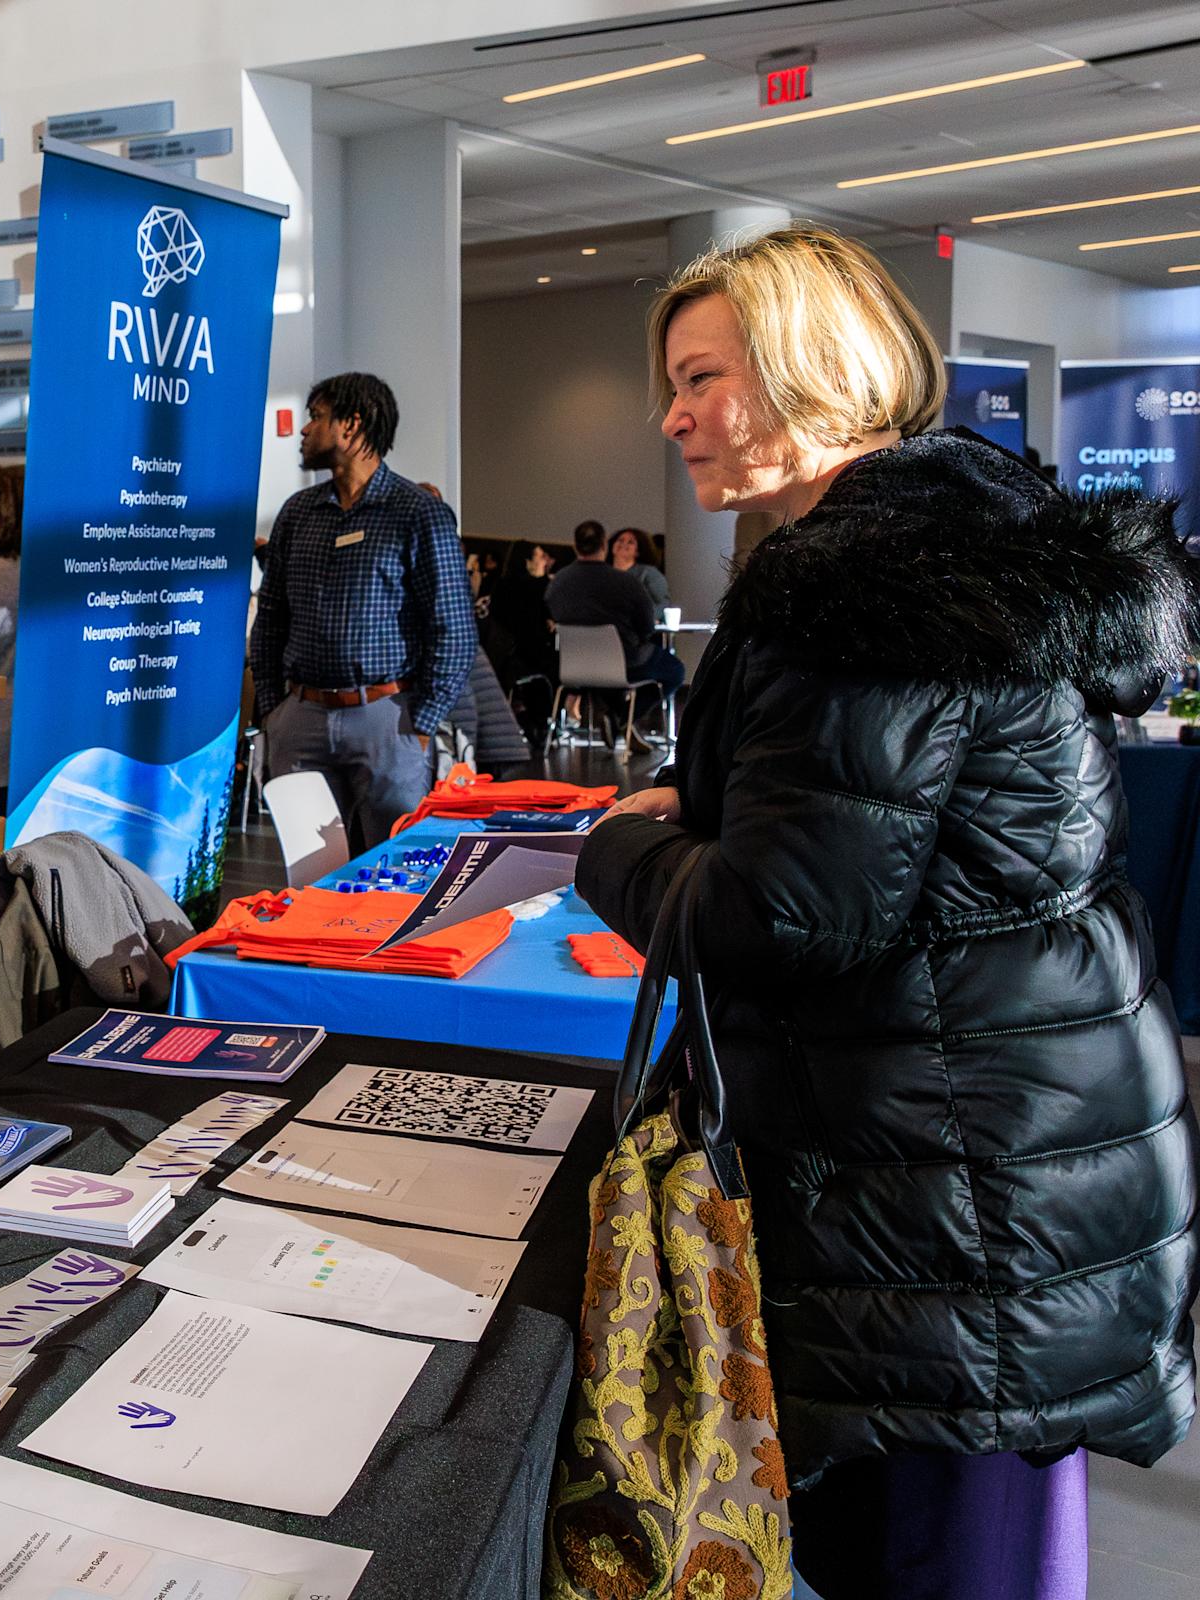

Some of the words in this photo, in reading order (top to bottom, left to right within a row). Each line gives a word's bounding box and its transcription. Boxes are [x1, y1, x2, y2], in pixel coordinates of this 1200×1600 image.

[767, 66, 809, 106] EXIT
[108, 301, 214, 374] RIVIA
[133, 373, 189, 405] MIND
[1170, 391, 1200, 407] SO
[132, 456, 182, 475] Psychiatry
[1079, 446, 1176, 469] Campus
[120, 489, 188, 509] Psychotherapy
[83, 523, 127, 541] Employee
[128, 523, 178, 539] Assistance
[179, 524, 215, 541] Programs
[64, 557, 107, 573] Women's
[109, 556, 169, 574] Reproductive
[171, 556, 198, 571] Mental
[199, 555, 228, 570] Health
[87, 592, 120, 609] College
[121, 590, 158, 606] Student
[160, 587, 204, 604] Counseling
[83, 622, 172, 642] Neuropsychological
[174, 619, 201, 635] Testing
[109, 656, 136, 672] Group
[139, 654, 178, 670] Therapy
[106, 689, 131, 706] Psych
[133, 685, 177, 702] Nutrition
[208, 1234, 227, 1252] Calendar
[269, 1251, 288, 1268] January
[281, 1241, 296, 1253] 2025
[33, 1532, 51, 1550] success
[12, 1550, 25, 1562] every
[76, 1565, 97, 1583] Future
[91, 1550, 108, 1566] Goals
[161, 1579, 177, 1593] Help
